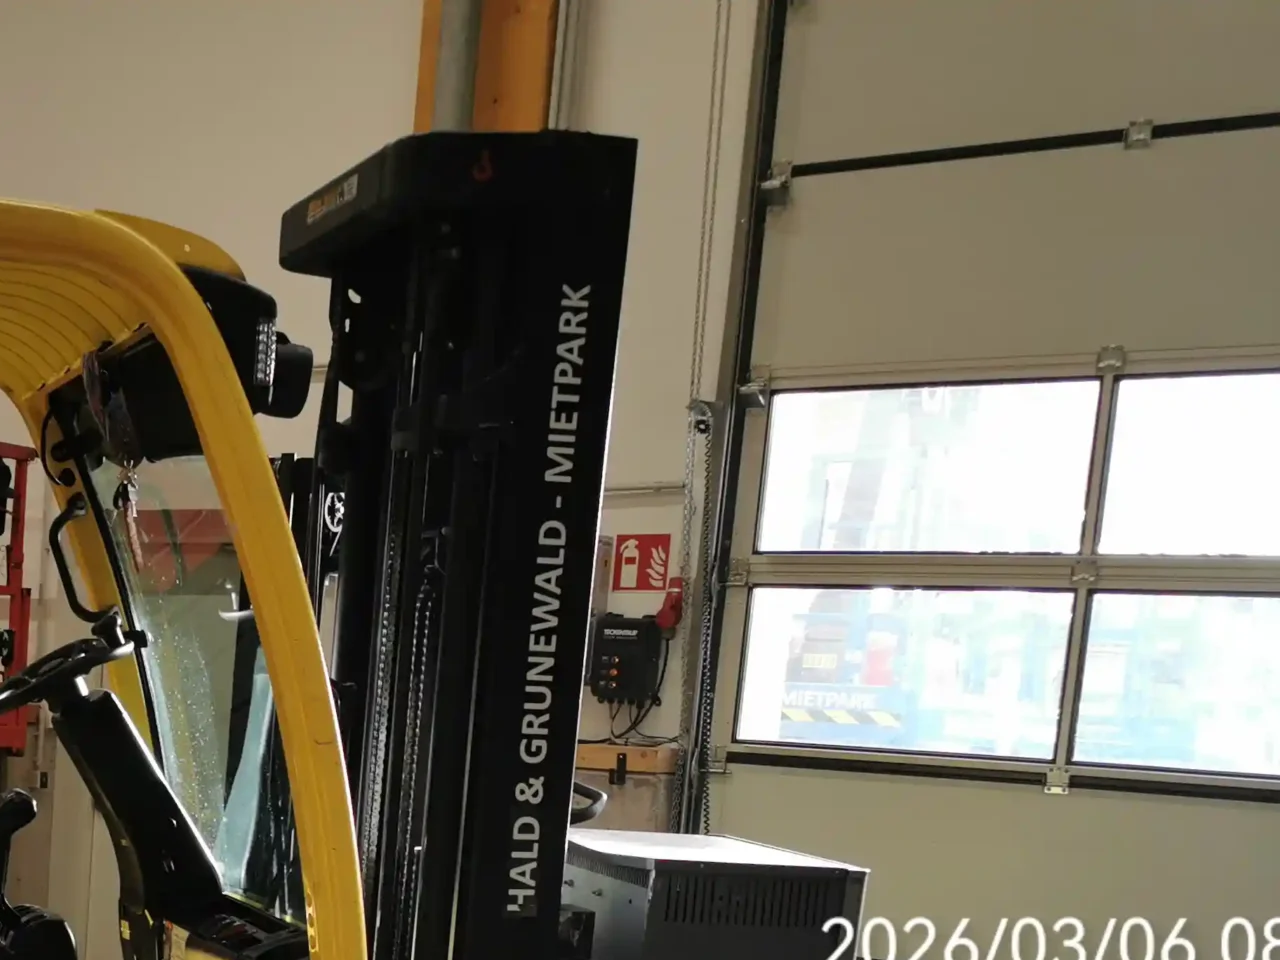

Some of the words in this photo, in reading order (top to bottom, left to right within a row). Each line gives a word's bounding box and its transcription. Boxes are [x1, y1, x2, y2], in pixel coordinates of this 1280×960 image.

[544, 284, 591, 483] MIETPARK
[556, 495, 562, 509] -
[520, 520, 567, 764] GRUNEWALD
[515, 776, 545, 802] &
[506, 815, 541, 911] HALD
